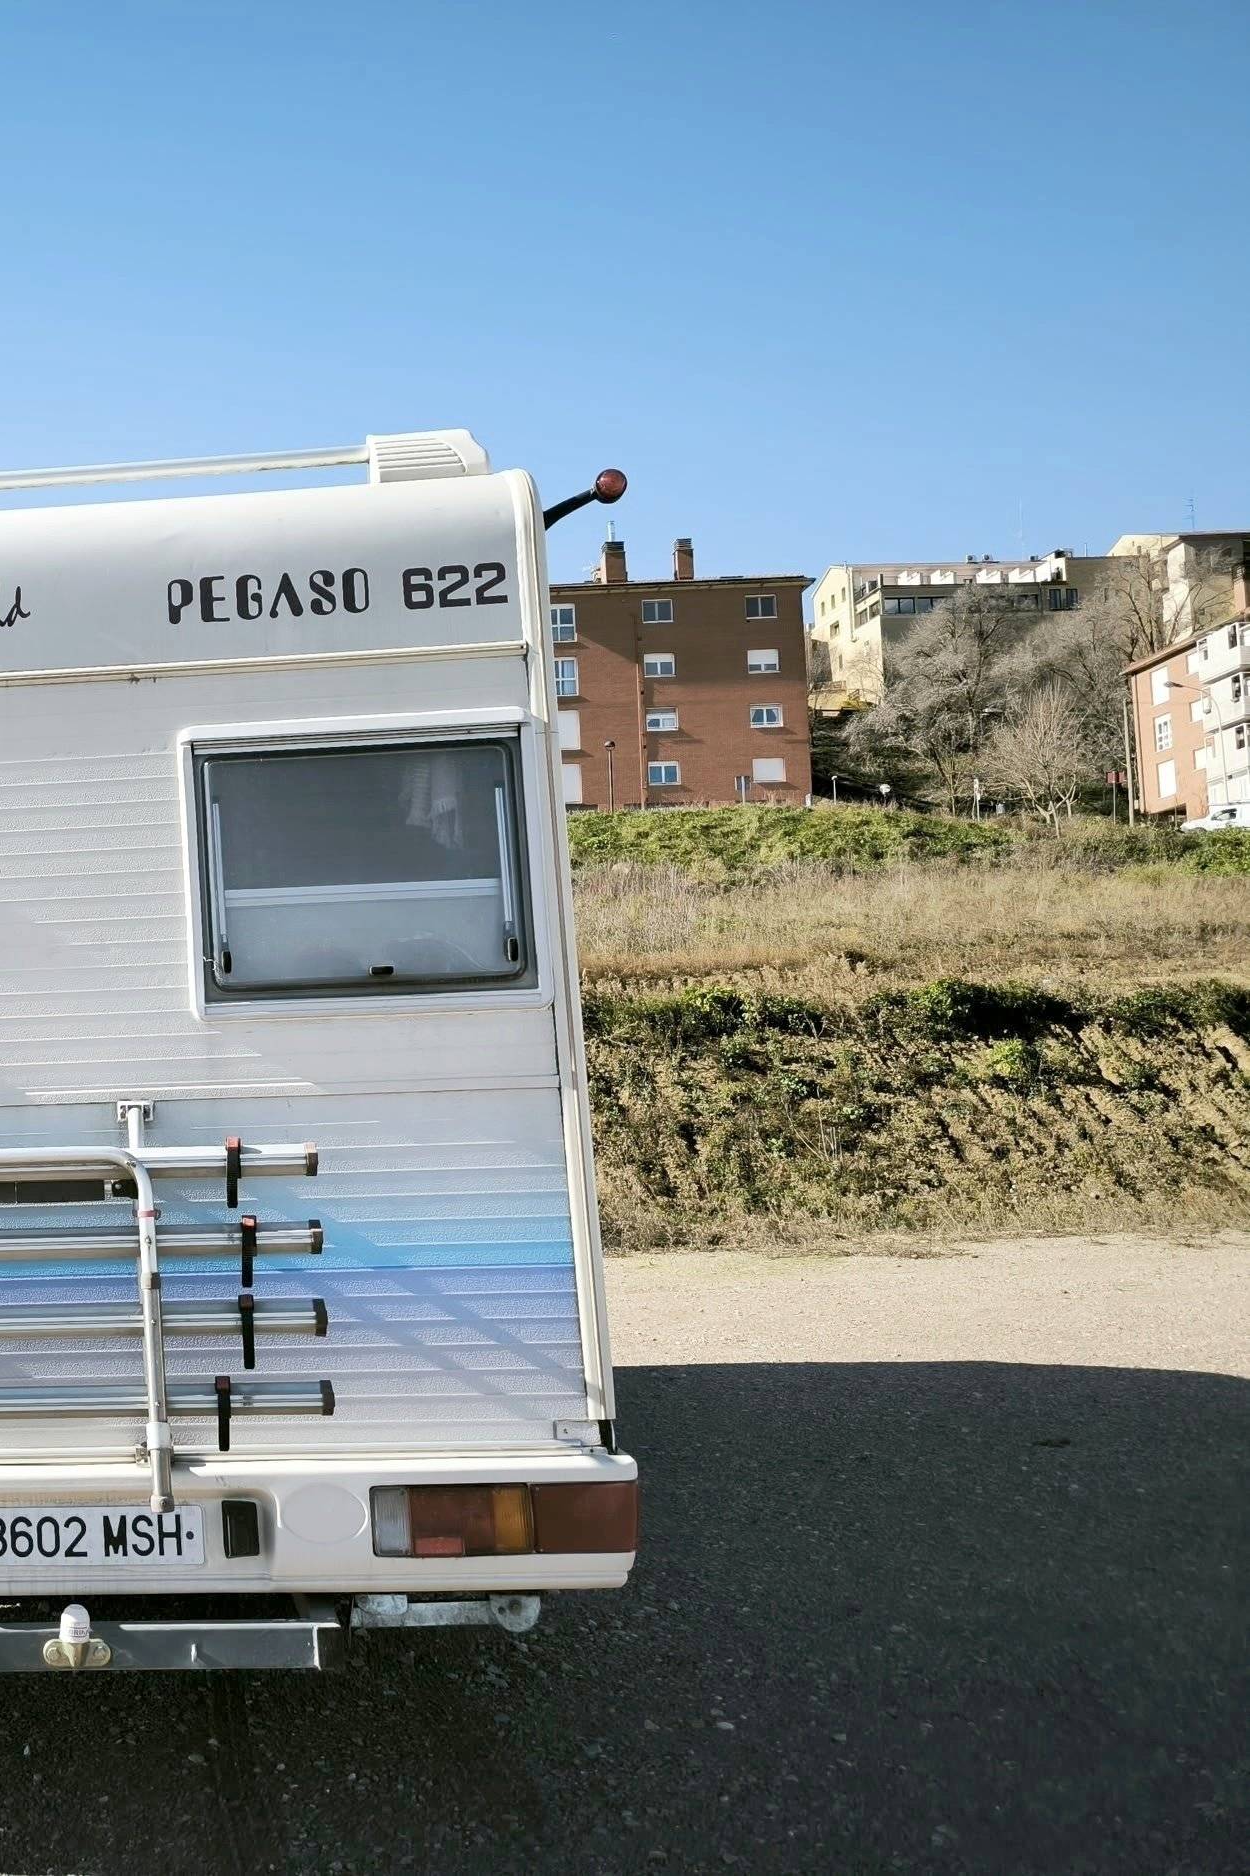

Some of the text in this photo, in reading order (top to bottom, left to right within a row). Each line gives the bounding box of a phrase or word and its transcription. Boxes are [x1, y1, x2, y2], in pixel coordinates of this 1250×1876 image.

[167, 562, 509, 625] PEGASO 622
[102, 1514, 183, 1557] MSH
